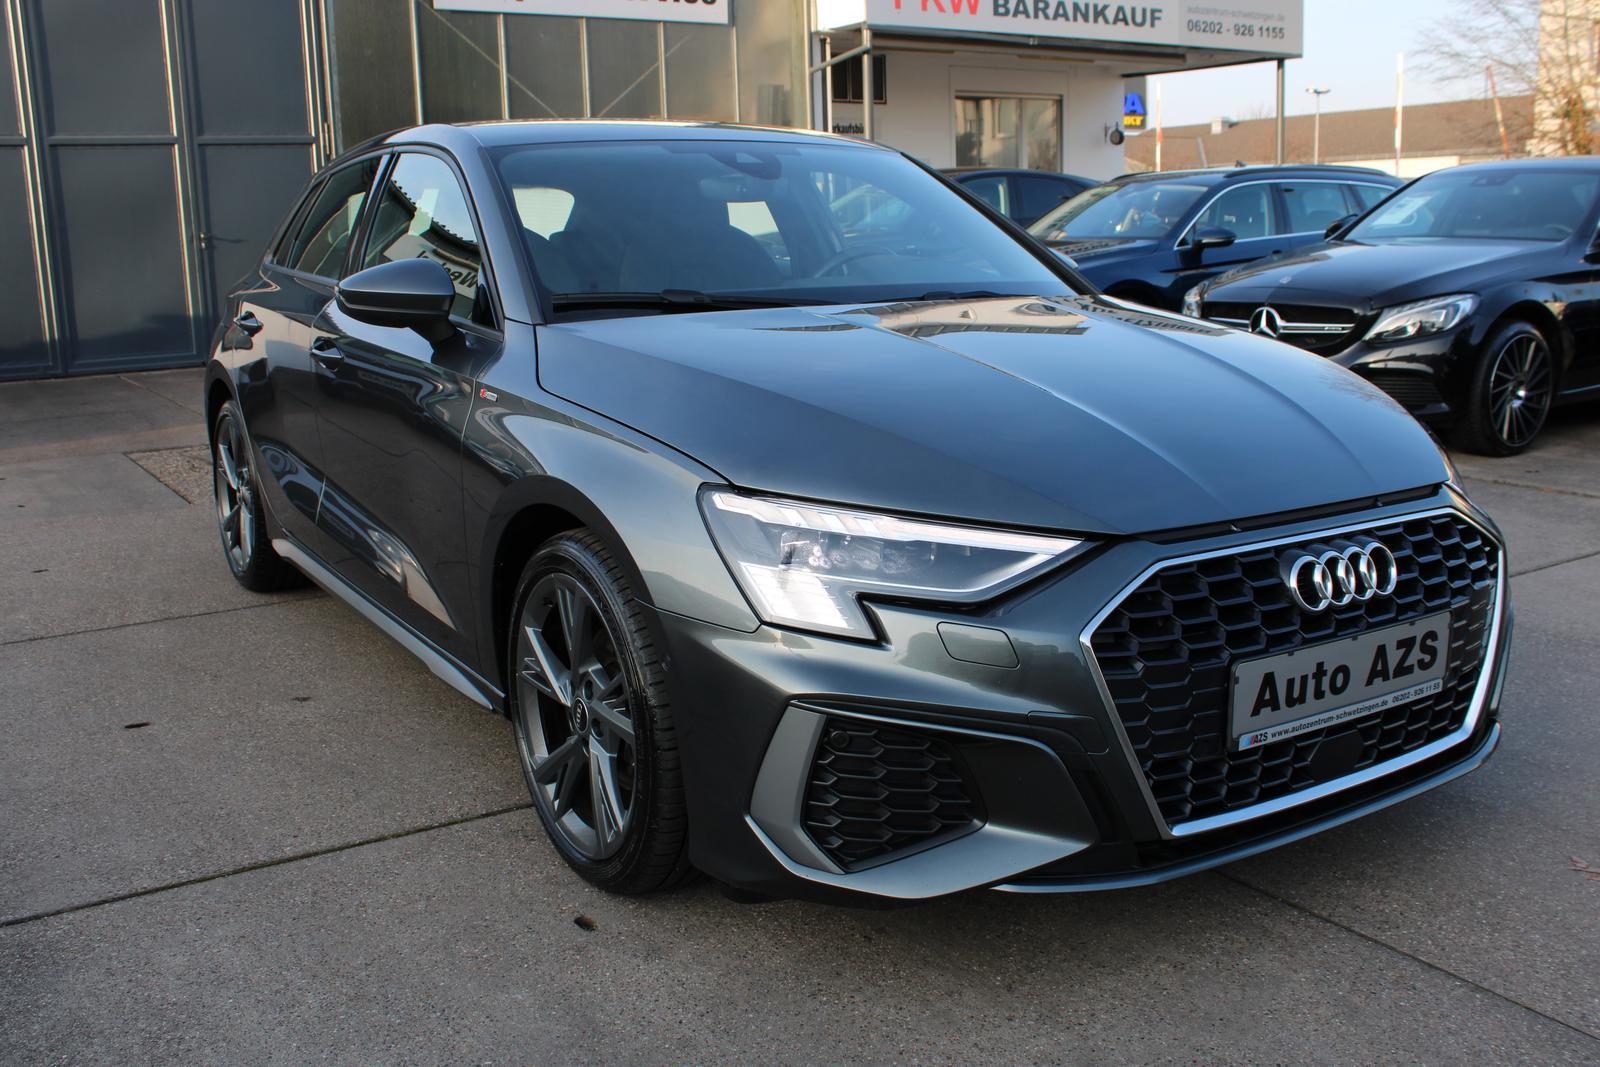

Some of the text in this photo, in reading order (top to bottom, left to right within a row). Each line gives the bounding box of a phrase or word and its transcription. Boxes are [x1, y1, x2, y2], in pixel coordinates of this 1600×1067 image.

[993, 0, 1162, 28] BARANKAUF
[1187, 19, 1223, 34] 06202
[1233, 23, 1254, 37] 926
[1258, 26, 1285, 39] 1155
[1250, 630, 1438, 717] Auto AZS
[1271, 700, 1388, 738] www.autozentrum-schwetzingen.de
